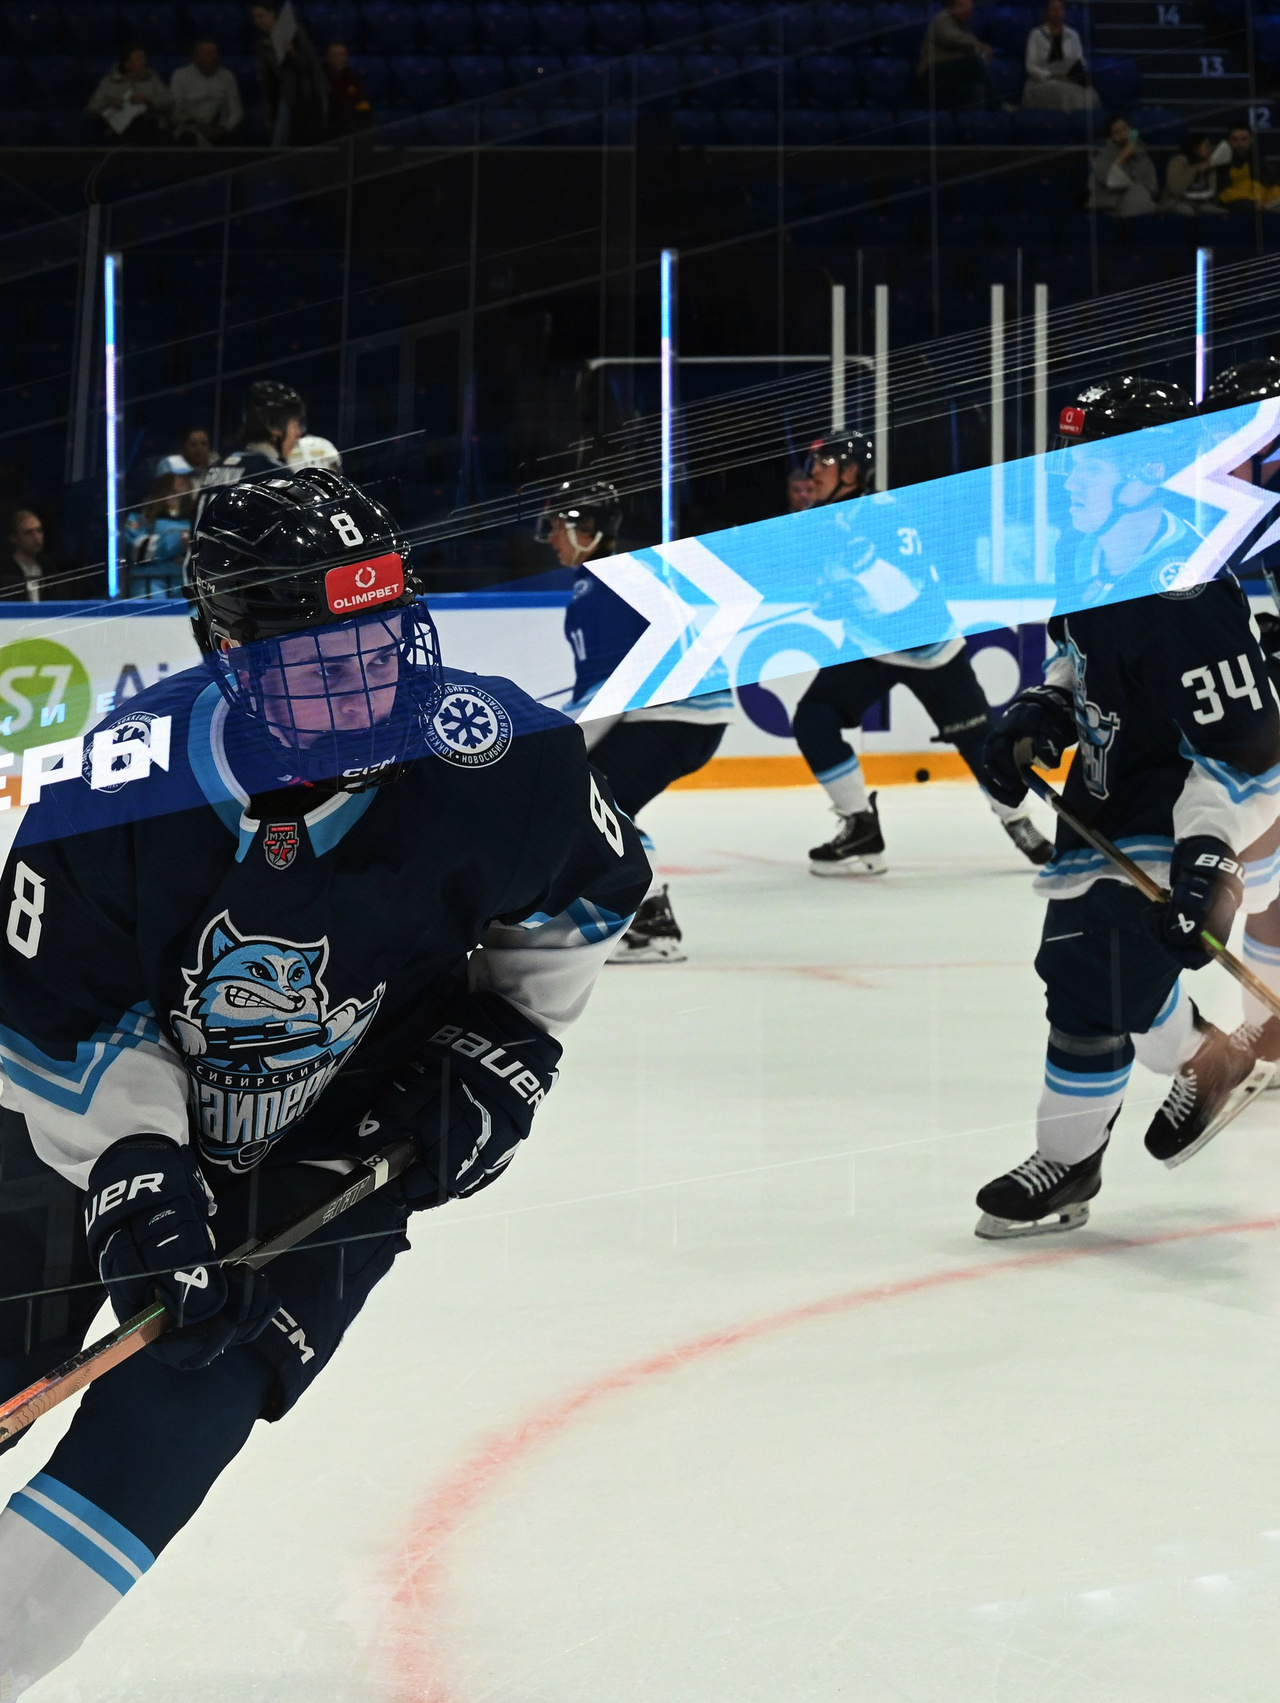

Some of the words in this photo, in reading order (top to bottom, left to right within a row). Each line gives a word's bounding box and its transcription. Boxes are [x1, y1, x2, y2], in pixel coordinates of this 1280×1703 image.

[1157, 4, 1180, 26] 14
[1199, 55, 1225, 77] 13
[1248, 106, 1272, 129] 12
[330, 512, 364, 547] 8
[333, 583, 399, 610] OLIMPBET
[1180, 652, 1264, 725] 34
[477, 691, 506, 721] ОБЛАСТЬ
[461, 722, 510, 764] НОВОСИБИРСКАЯ
[342, 755, 397, 778] CCM
[589, 771, 625, 858] 8
[270, 831, 295, 841] МХЛ
[6, 860, 46, 959] 8
[196, 1060, 321, 1087] СИБИРСКИЕ
[84, 1172, 166, 1237] UER
[272, 1307, 315, 1364] CM
